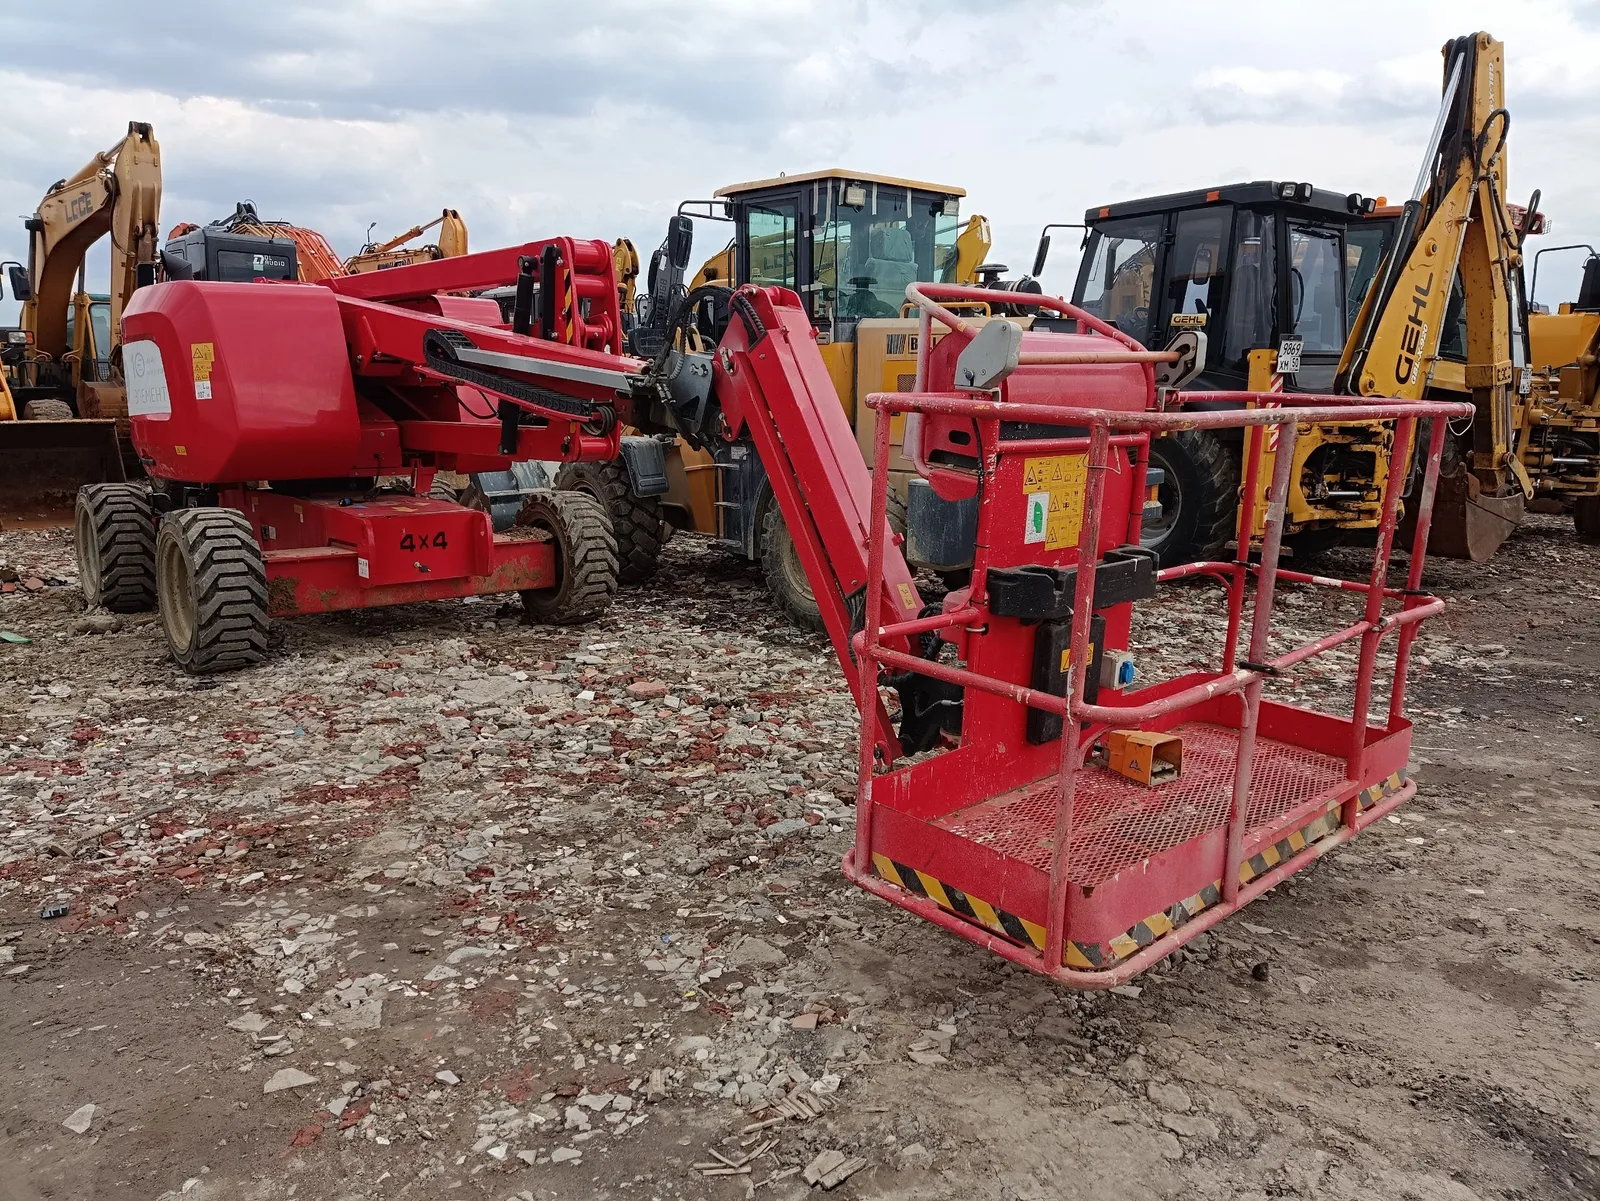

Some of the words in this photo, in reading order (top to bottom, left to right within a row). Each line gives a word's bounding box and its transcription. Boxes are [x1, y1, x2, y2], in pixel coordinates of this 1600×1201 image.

[1173, 315, 1203, 324] GEHL
[1395, 272, 1434, 385] GEHL
[1283, 342, 1302, 356] 9869
